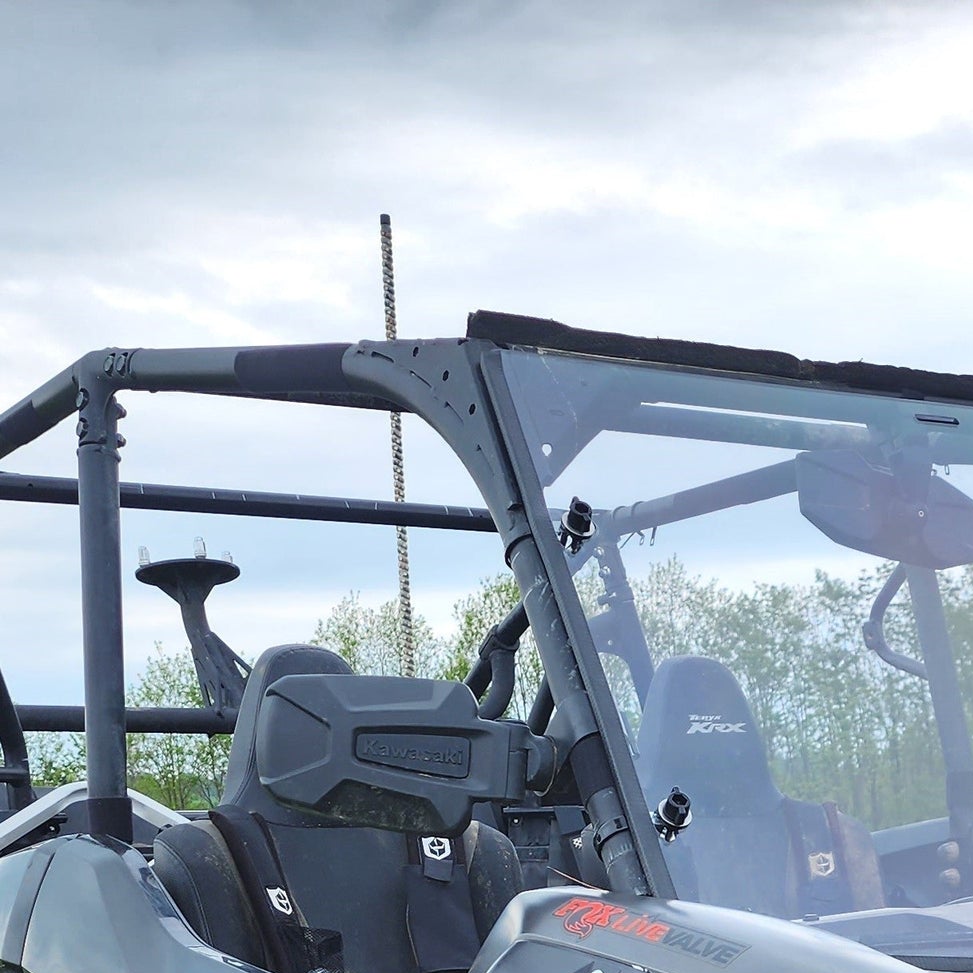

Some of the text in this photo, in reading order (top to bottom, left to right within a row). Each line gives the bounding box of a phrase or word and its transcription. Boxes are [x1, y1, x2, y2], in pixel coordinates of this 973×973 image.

[686, 721, 748, 734] KRX
[363, 739, 464, 766] Kawasaki
[552, 897, 626, 939] FOX
[661, 927, 742, 965] VALVE
